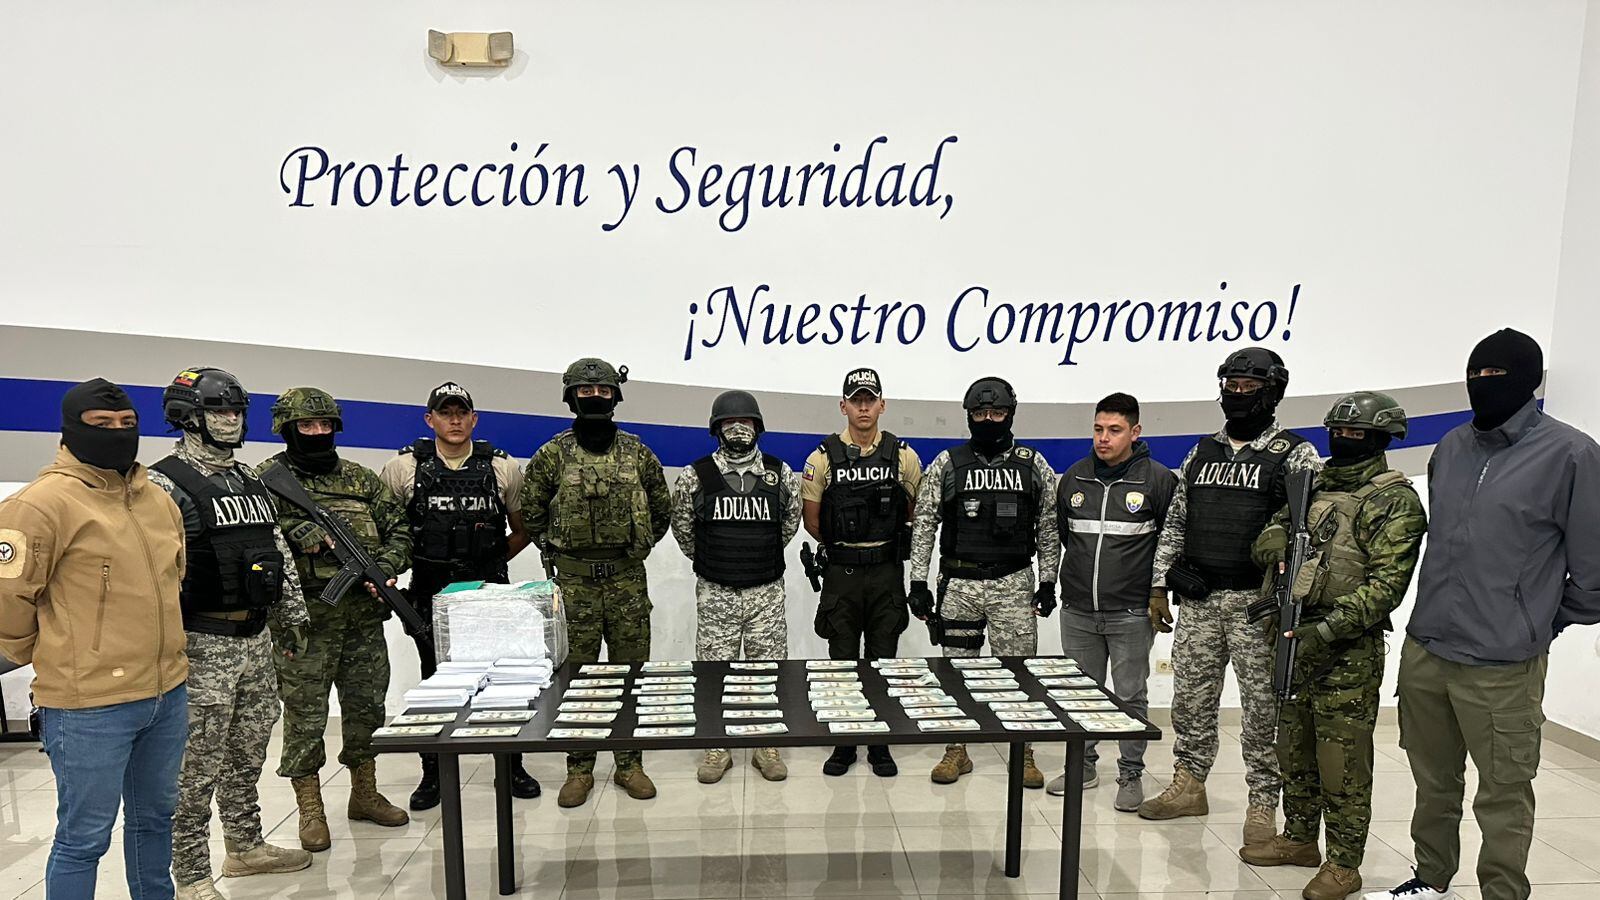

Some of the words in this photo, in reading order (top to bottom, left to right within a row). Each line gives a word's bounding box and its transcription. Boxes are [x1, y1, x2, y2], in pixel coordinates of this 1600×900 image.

[279, 142, 589, 208] Protección
[602, 163, 640, 232] y
[655, 135, 958, 233] Seguridad,
[684, 285, 926, 361] ¡Nuestro
[946, 281, 1302, 366] Compromiso!
[836, 466, 895, 482] POLICIA
[963, 468, 1024, 491] ADUANA
[1194, 462, 1262, 489] ADUANA
[712, 496, 771, 521] ADUANA
